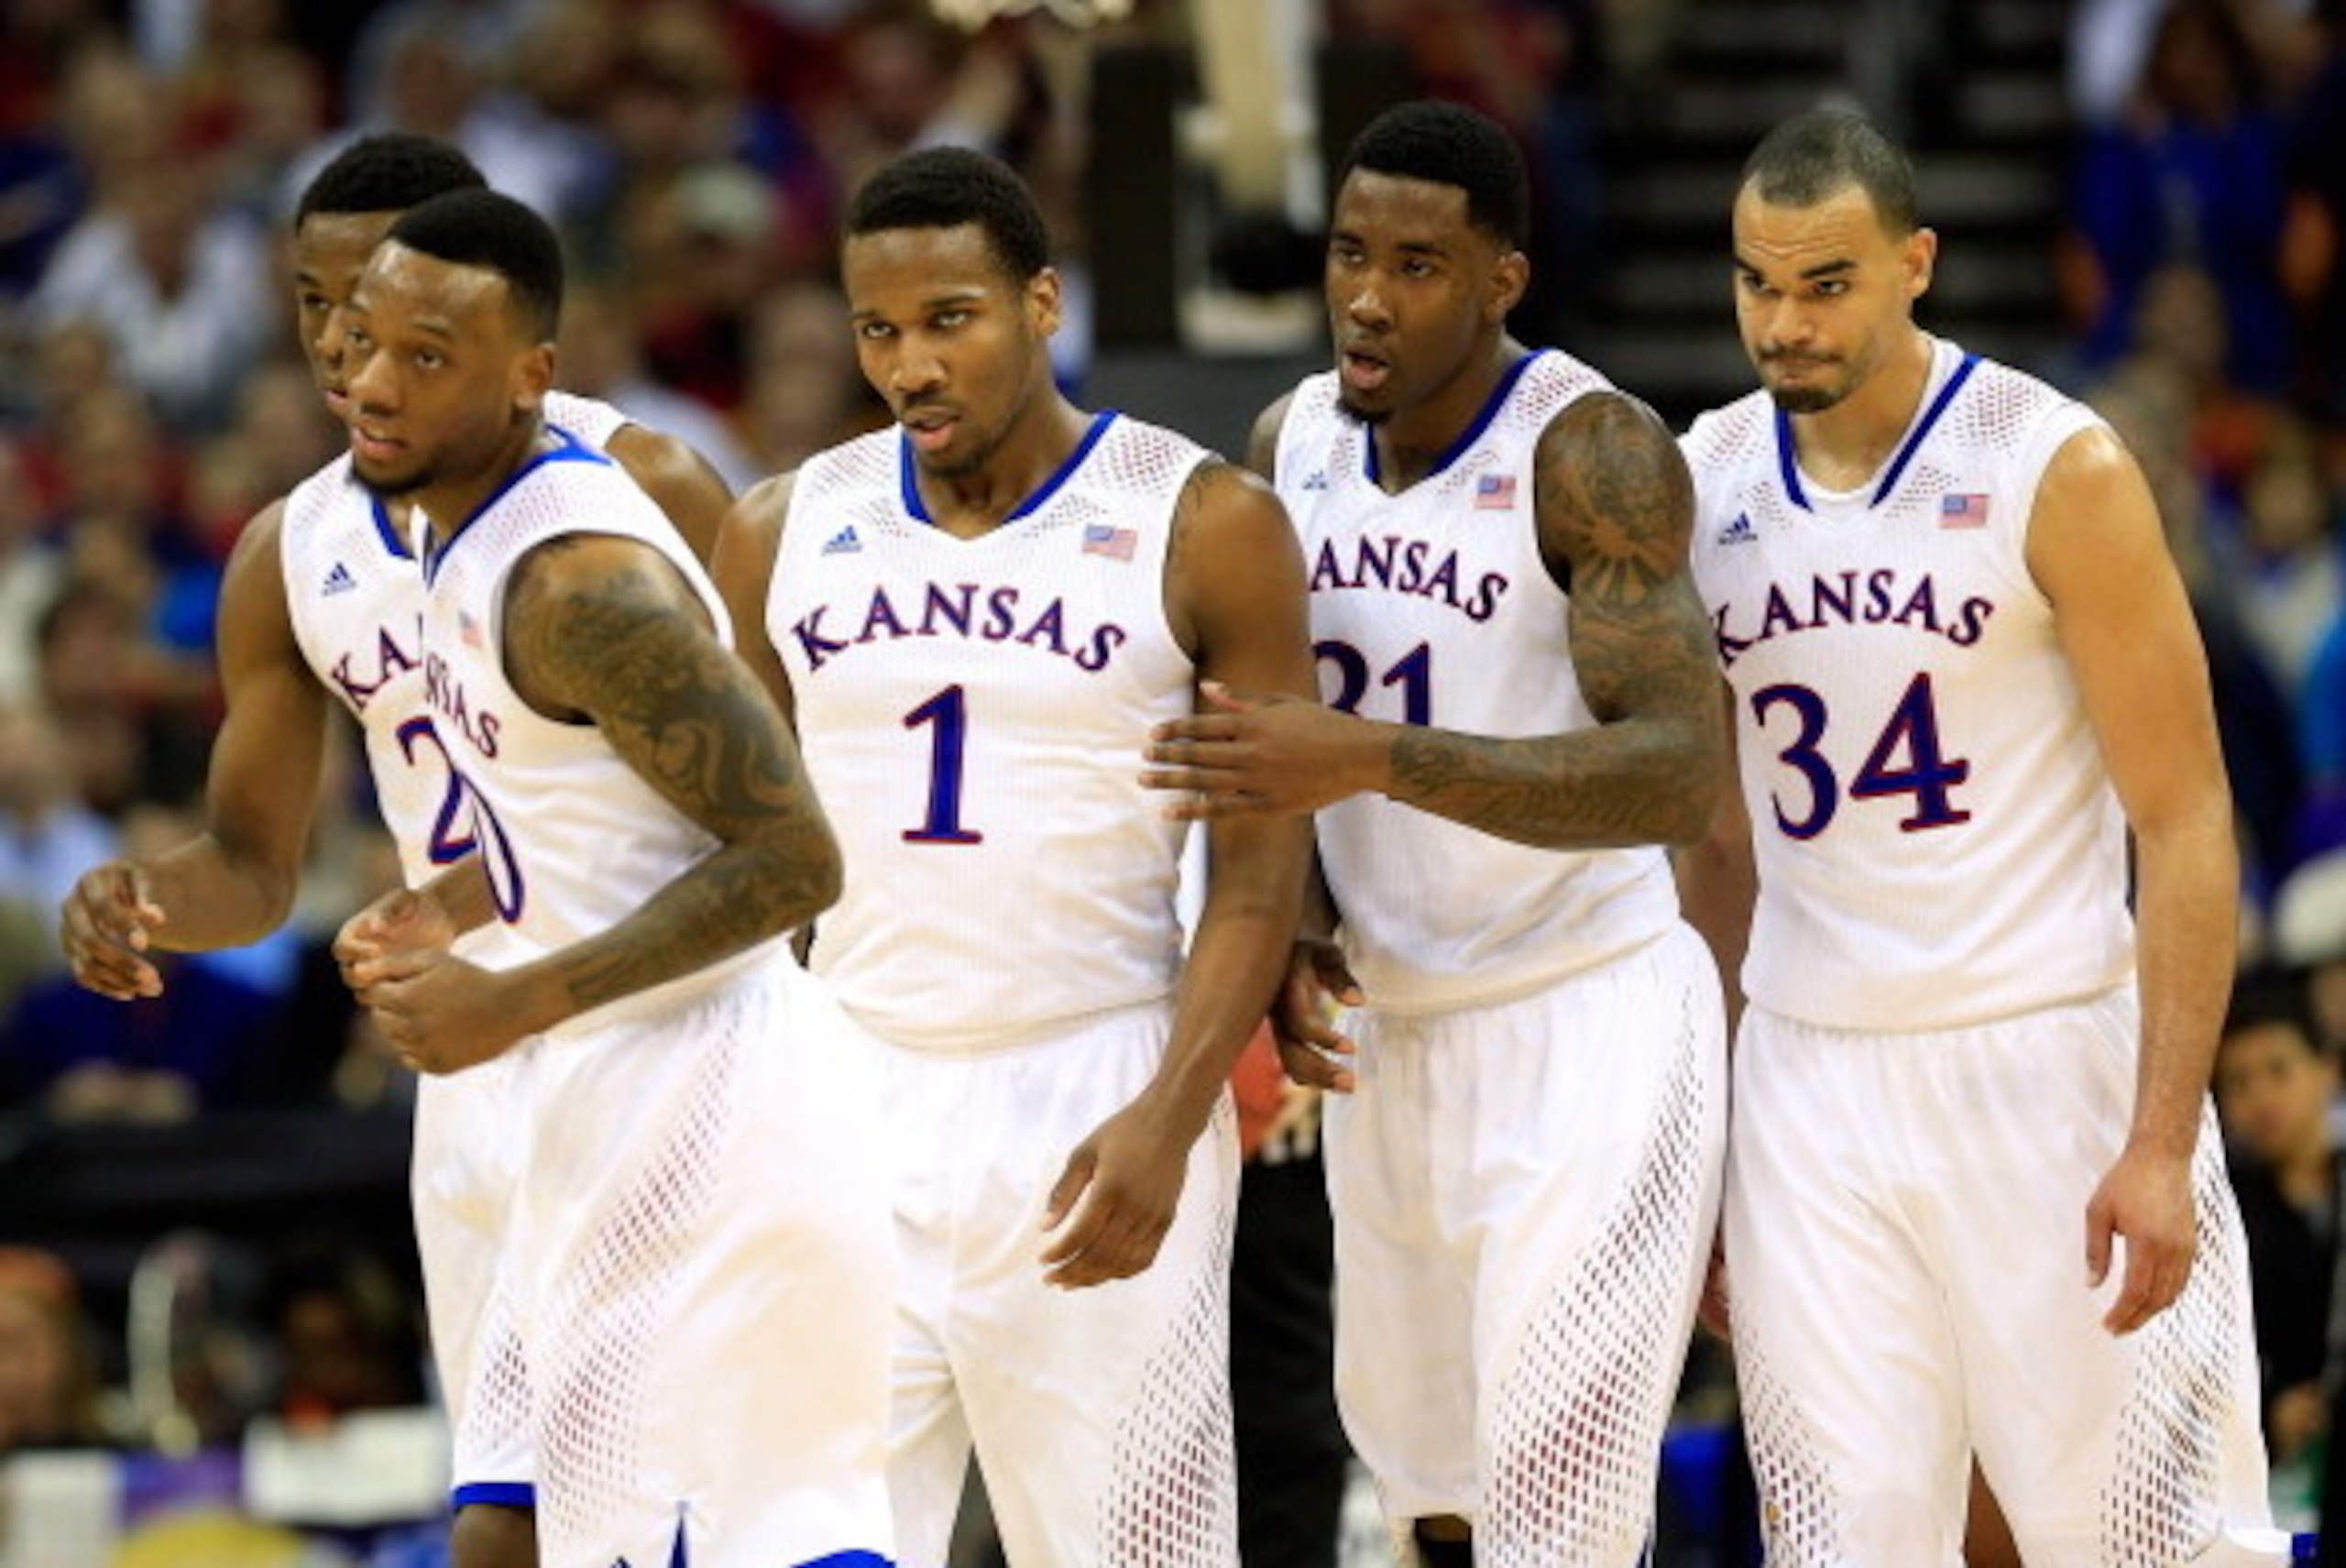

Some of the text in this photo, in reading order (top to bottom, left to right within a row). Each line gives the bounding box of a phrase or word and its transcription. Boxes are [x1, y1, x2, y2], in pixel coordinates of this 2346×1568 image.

[331, 611, 422, 714] KA
[791, 580, 1127, 673] KANSAS
[1709, 568, 1994, 670] KANSAS
[901, 684, 983, 845] 1
[1750, 671, 1971, 840] 34
